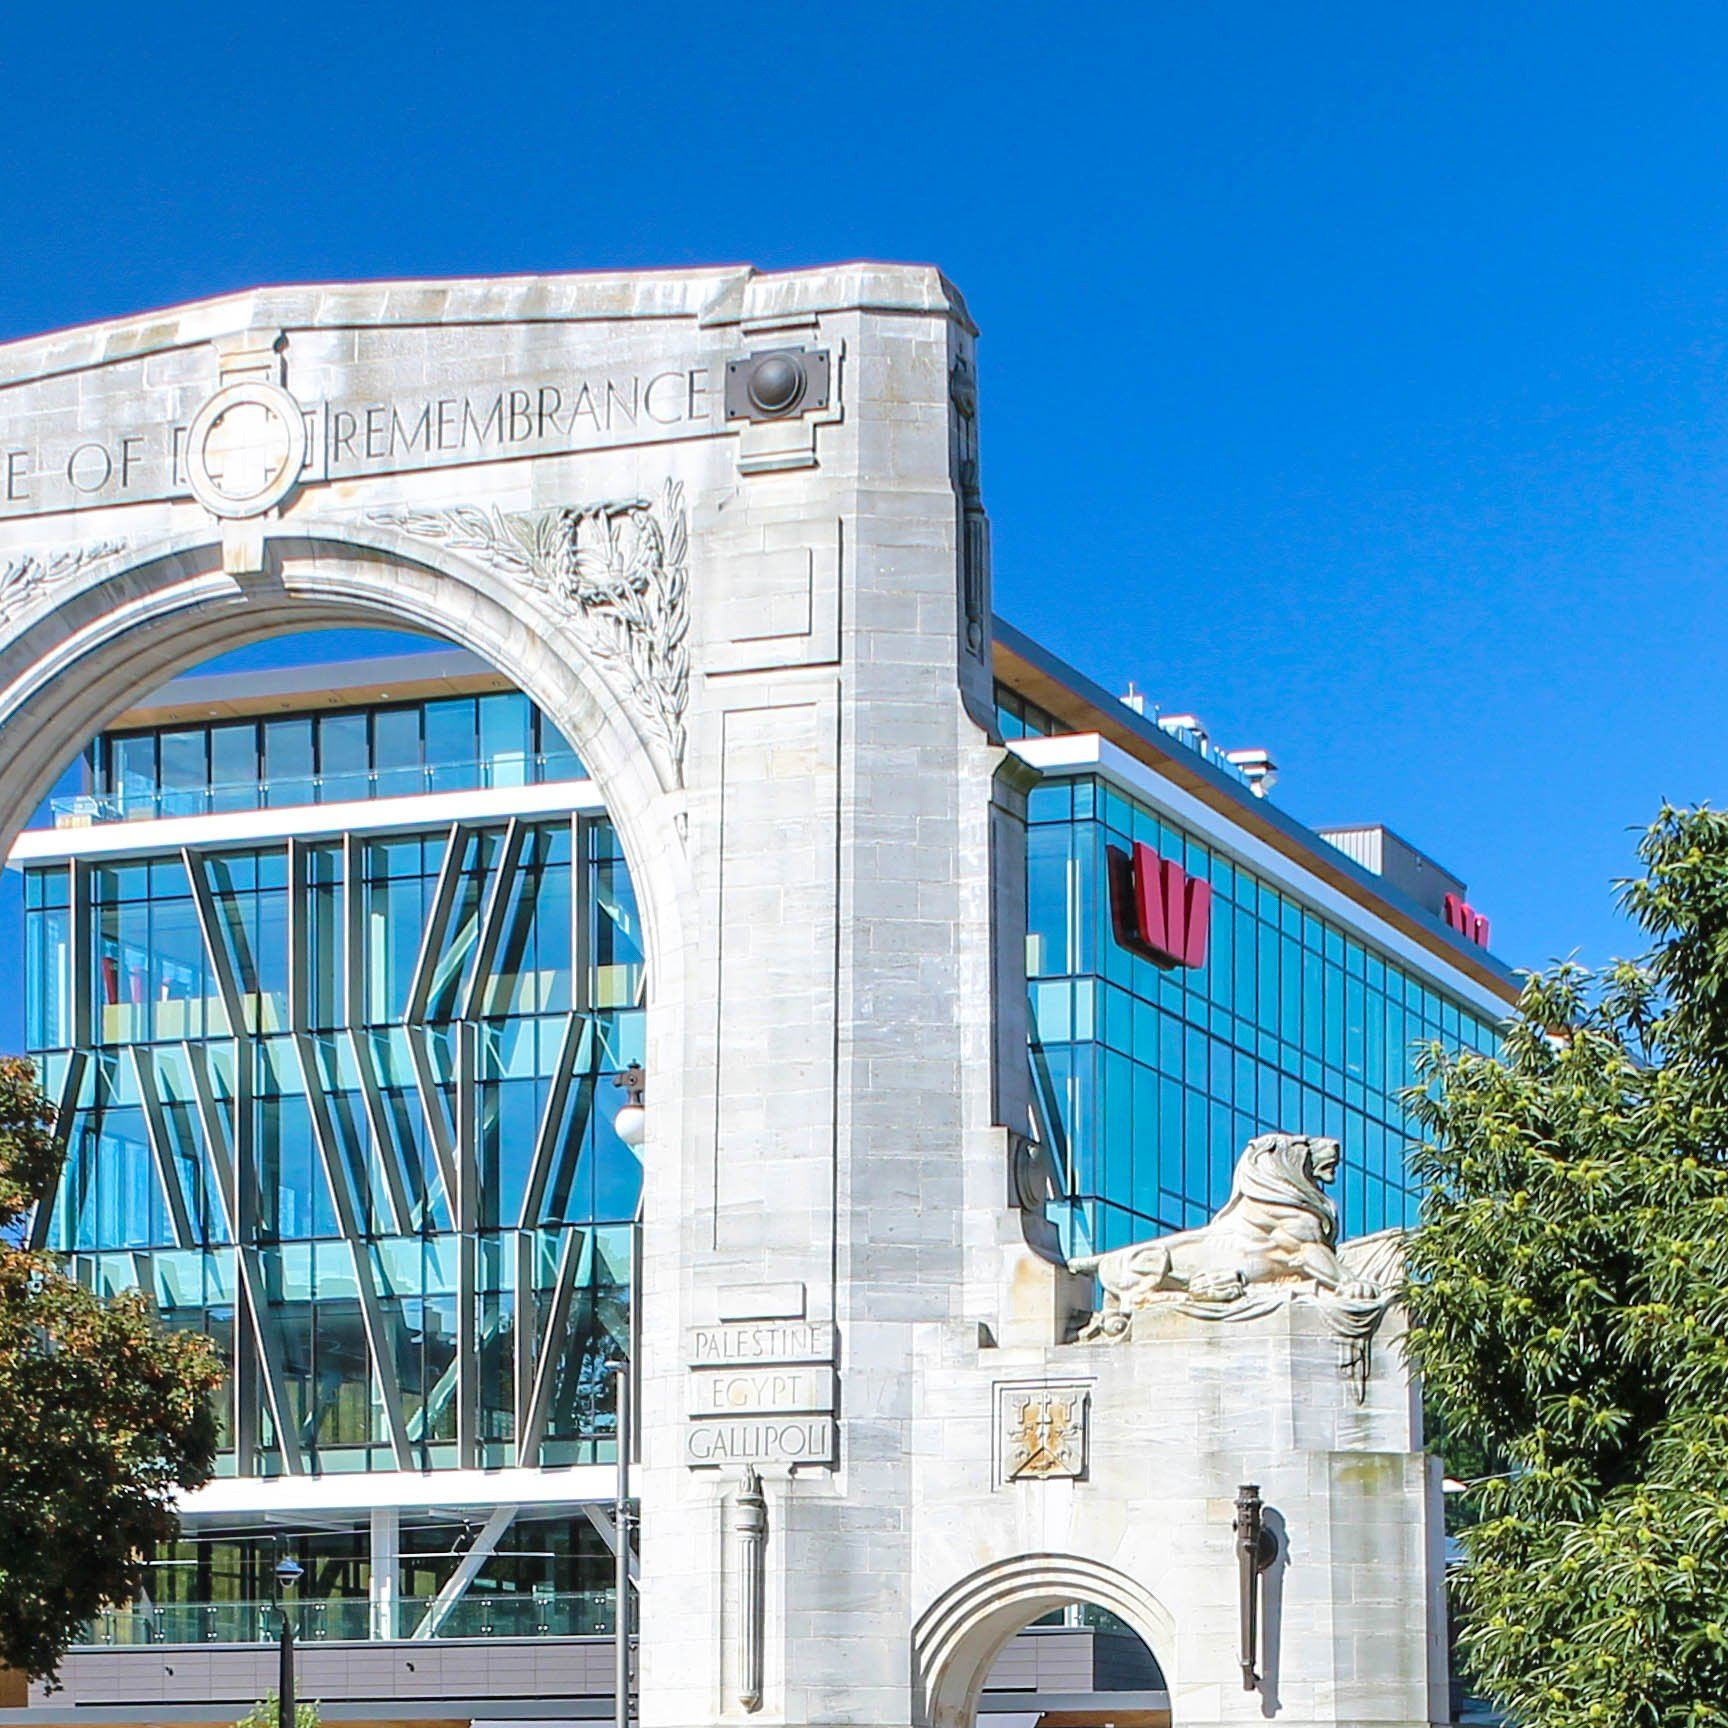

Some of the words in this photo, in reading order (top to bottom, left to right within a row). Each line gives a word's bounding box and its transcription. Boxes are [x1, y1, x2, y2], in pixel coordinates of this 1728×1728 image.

[67, 437, 145, 493] OF
[333, 368, 711, 463] REMEMBRANCE
[695, 1327, 822, 1358] PALESTINE
[713, 1376, 802, 1408] EGYPT
[688, 1424, 825, 1459] GALLIPOLI
